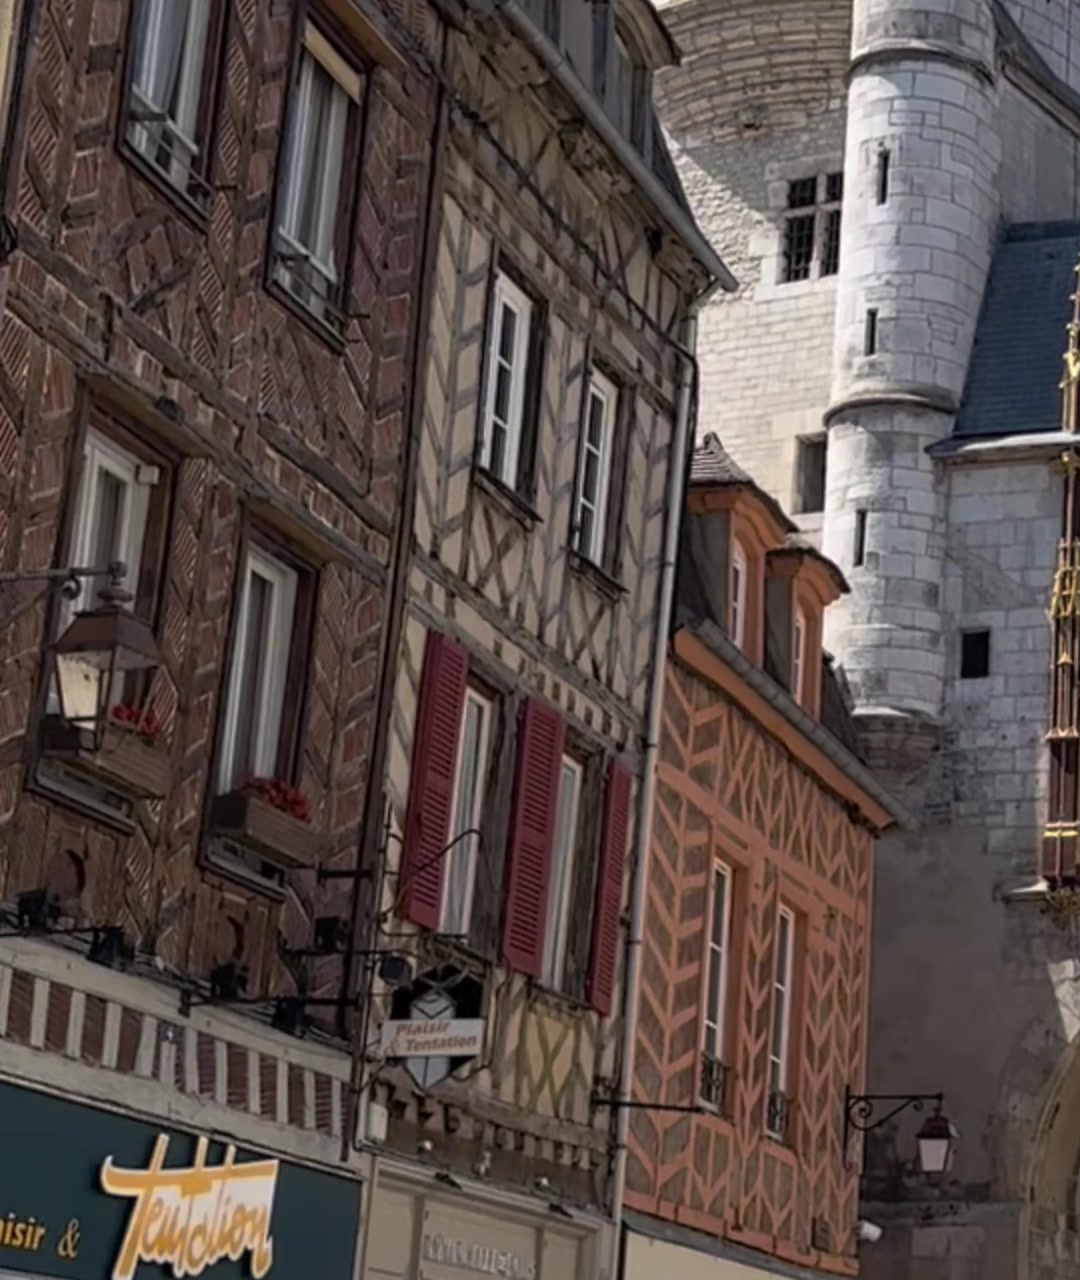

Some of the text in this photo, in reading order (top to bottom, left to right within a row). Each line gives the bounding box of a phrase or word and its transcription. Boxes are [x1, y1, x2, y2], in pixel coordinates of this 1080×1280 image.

[396, 1022, 449, 1036] Plaisir
[406, 1036, 477, 1052] Tentation
[57, 1217, 80, 1258] &
